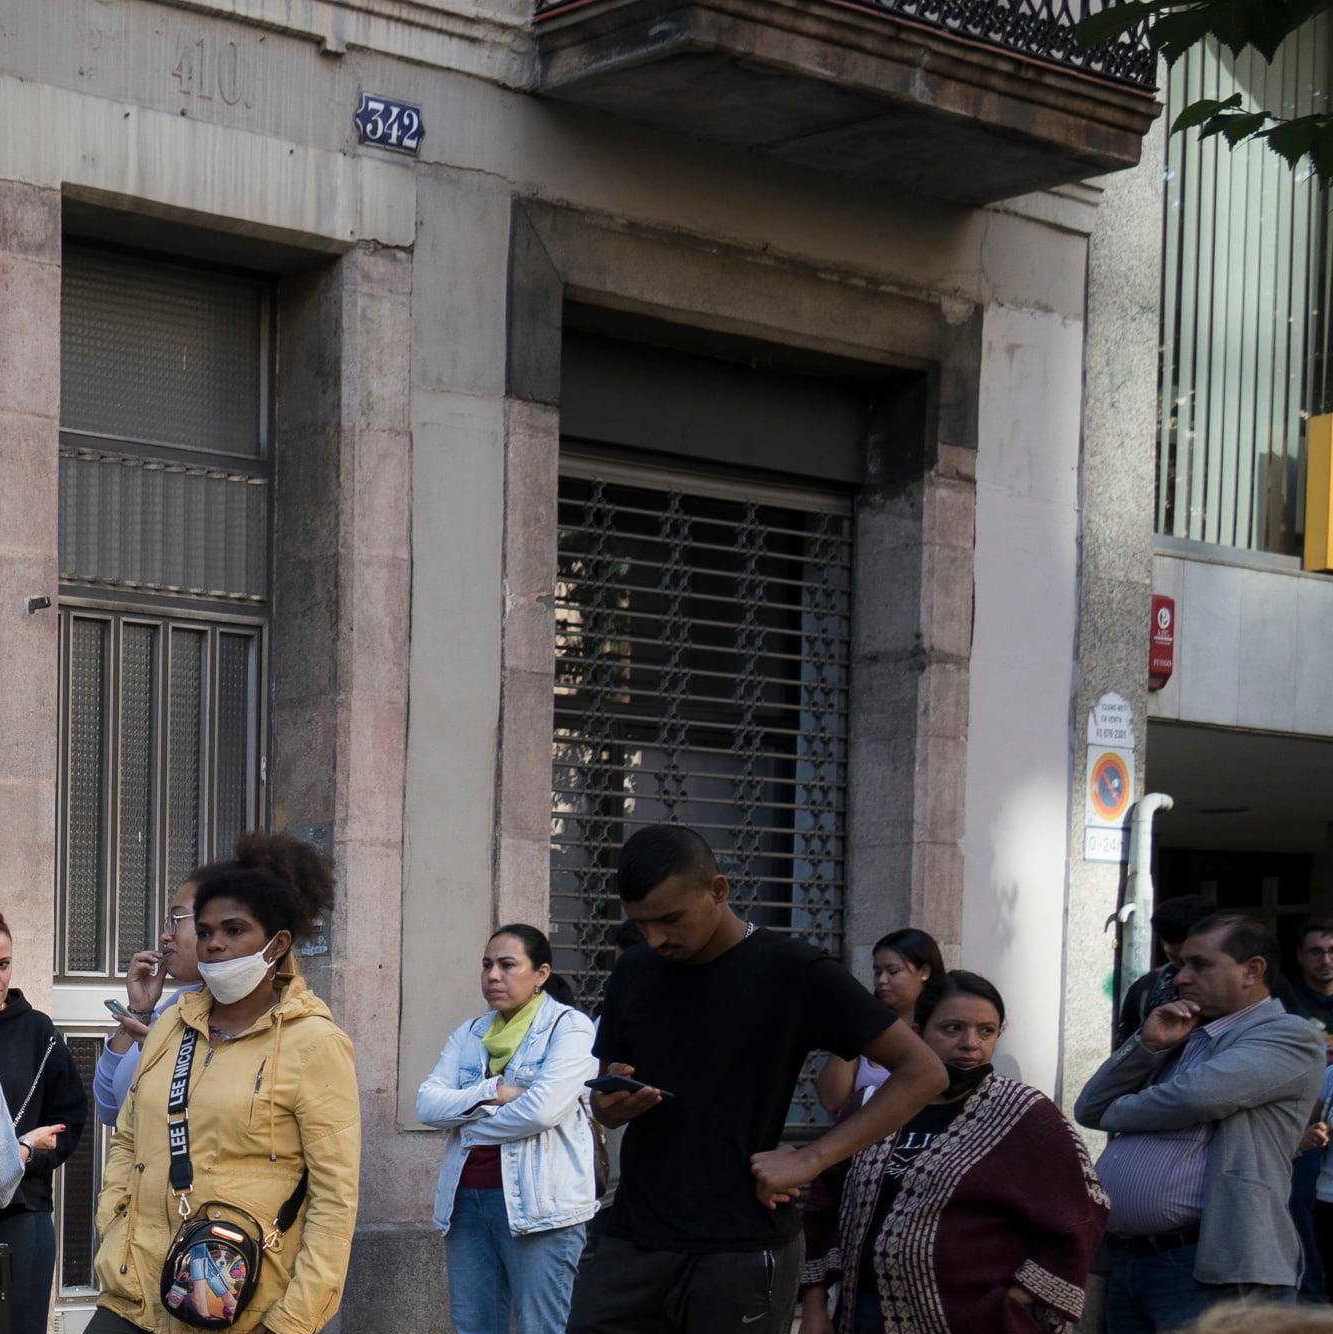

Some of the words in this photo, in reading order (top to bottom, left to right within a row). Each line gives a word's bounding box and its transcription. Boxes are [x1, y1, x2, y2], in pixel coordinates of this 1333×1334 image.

[366, 101, 422, 150] 342
[174, 1029, 195, 1079] NICOLE
[169, 1078, 187, 1107] LEE
[169, 1126, 188, 1156] LEE
